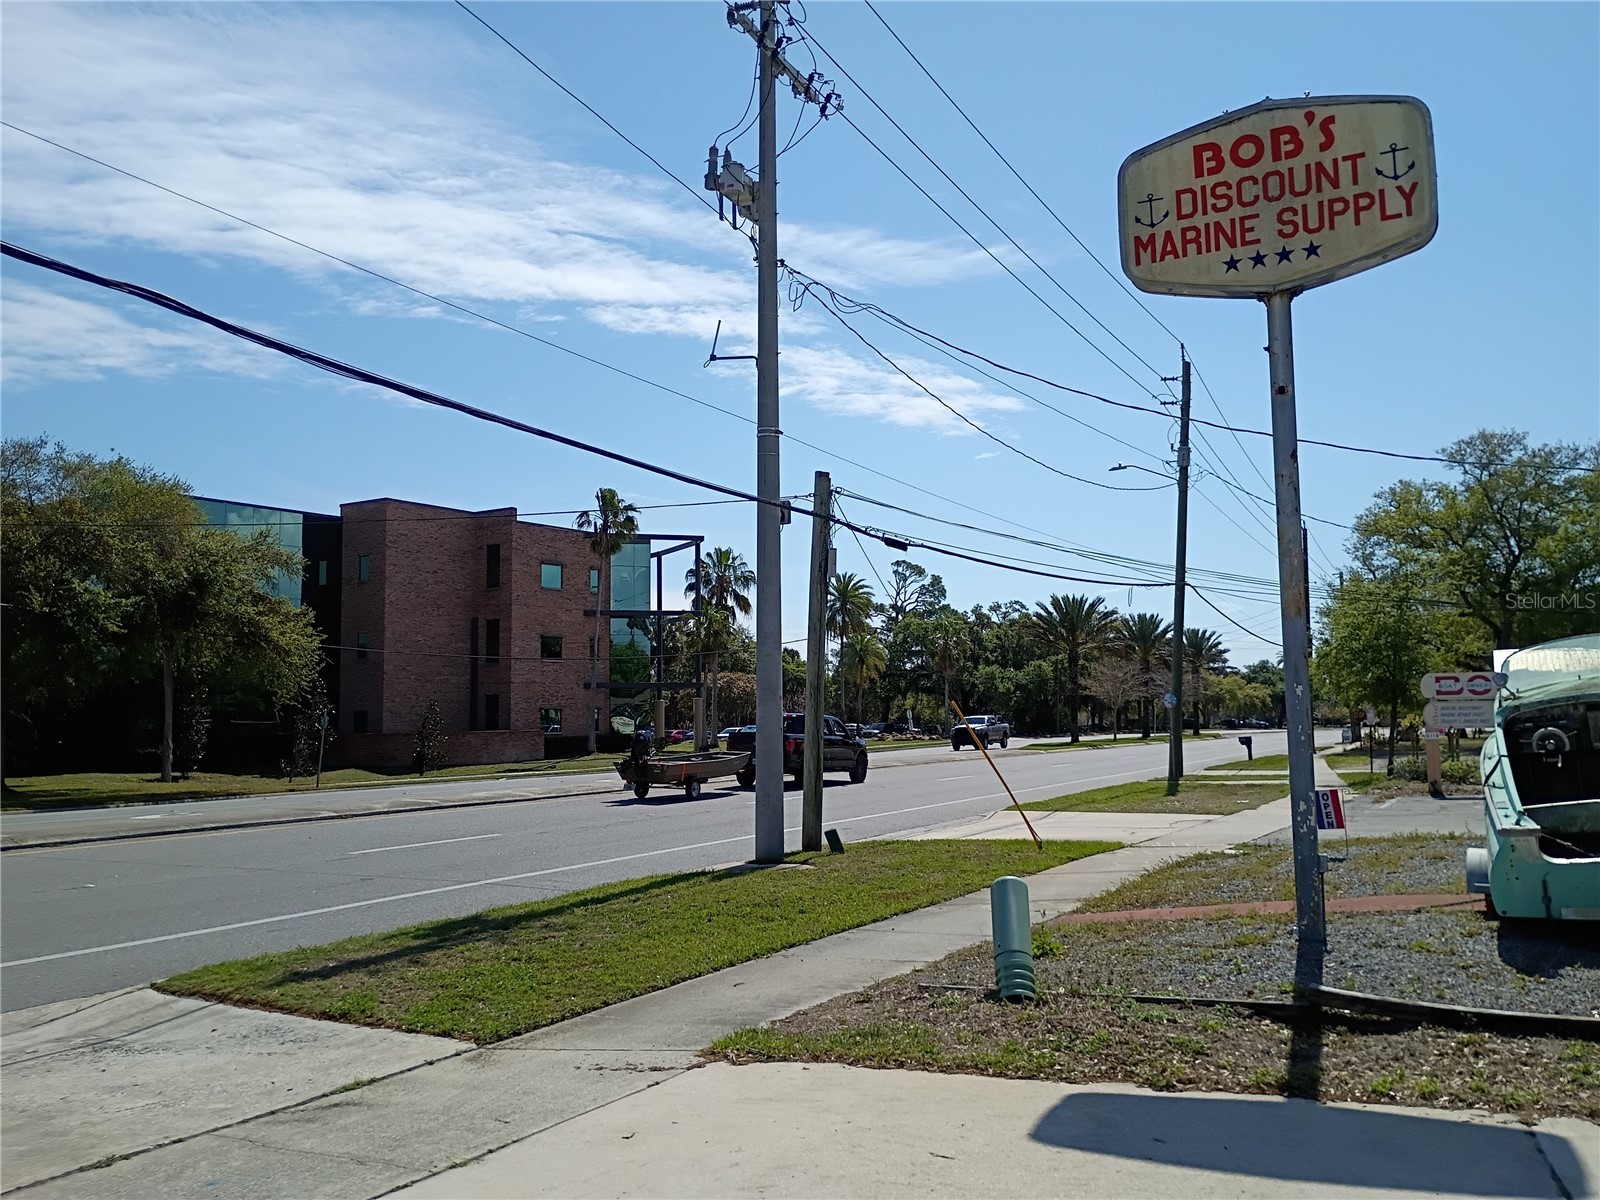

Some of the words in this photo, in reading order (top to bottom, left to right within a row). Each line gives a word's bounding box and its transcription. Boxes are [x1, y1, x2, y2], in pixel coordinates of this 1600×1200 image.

[1193, 110, 1335, 179] BOB'S
[1175, 152, 1366, 221] DISCOUNT
[1133, 213, 1261, 267] MARINE
[1276, 181, 1419, 240] SUPPLY
[1321, 792, 1335, 829] OPEN
